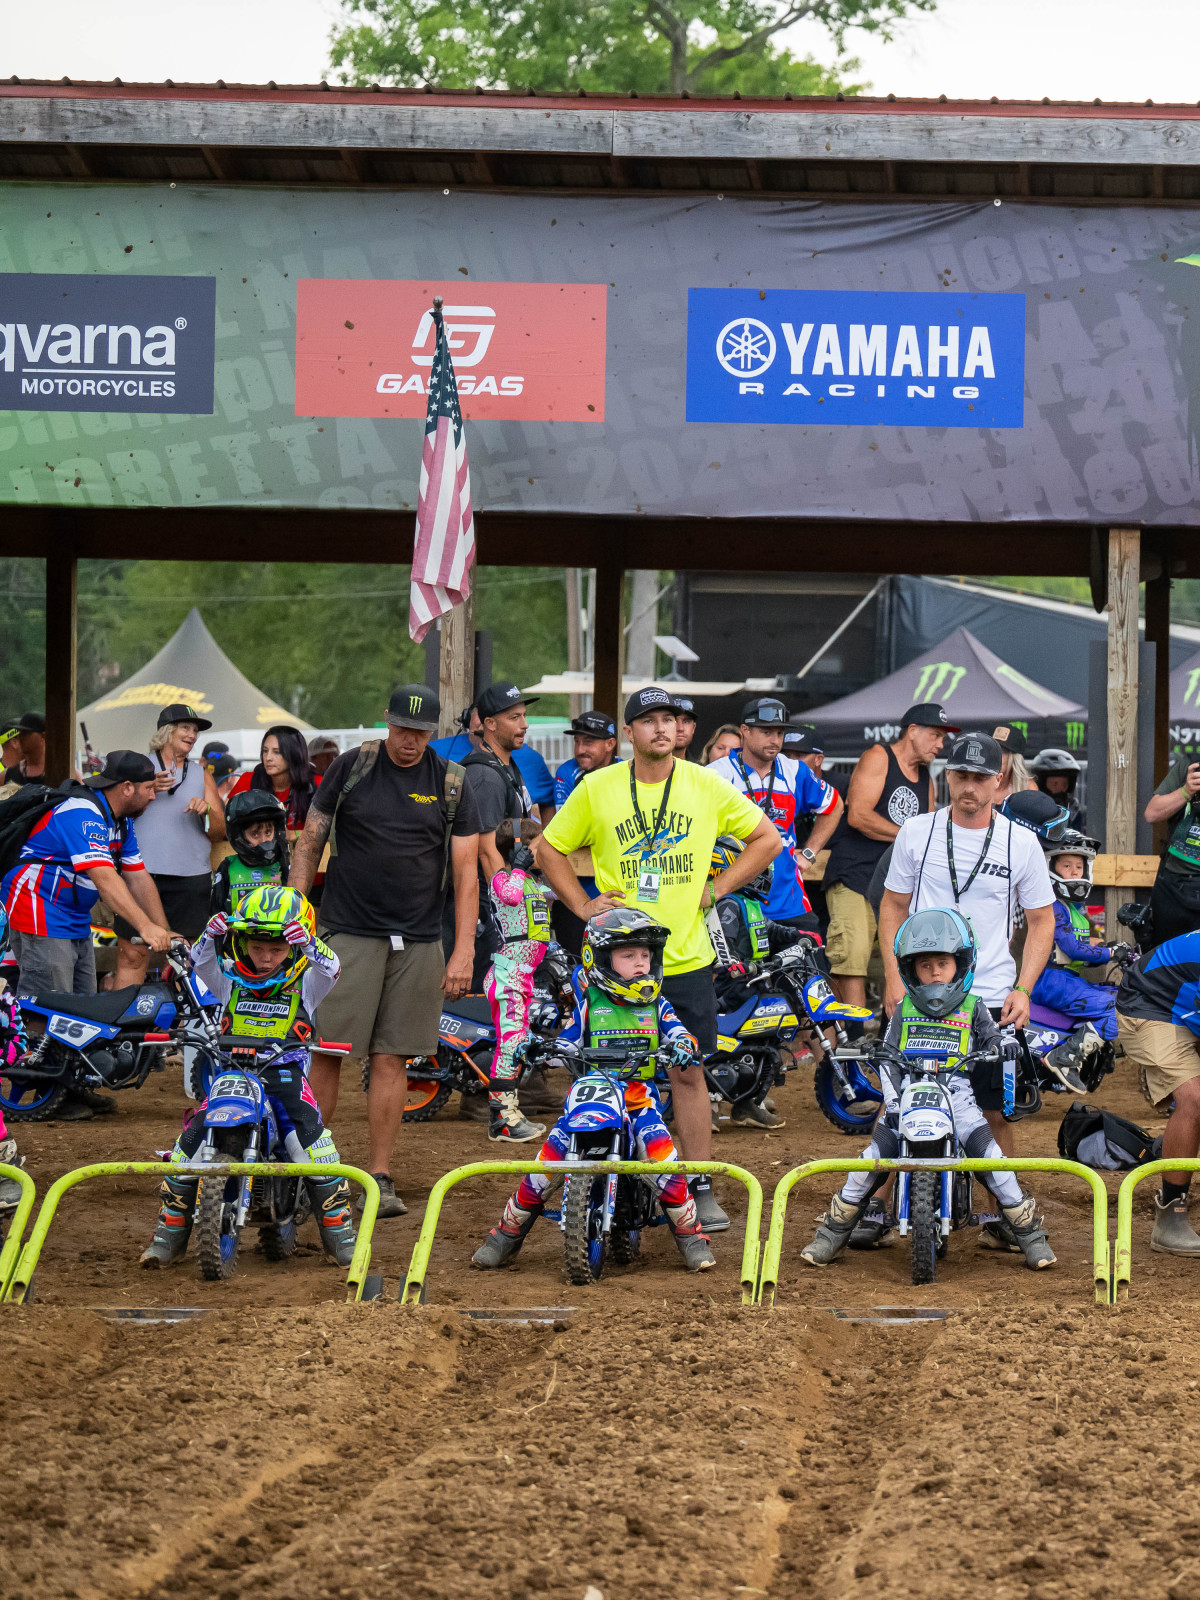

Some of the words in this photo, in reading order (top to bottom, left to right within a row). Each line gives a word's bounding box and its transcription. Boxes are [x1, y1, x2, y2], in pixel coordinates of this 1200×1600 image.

[780, 322, 996, 378] YAMAHA
[21, 378, 176, 398] MOTORCYCLES
[739, 382, 980, 399] RACING
[644, 875, 653, 888] A
[236, 1002, 290, 1015] CHAMPIONSHIP
[54, 1018, 87, 1039] 56
[906, 1040, 960, 1051] CHAMPIONSHIP
[217, 1079, 250, 1097] 23
[575, 1085, 615, 1104] 92
[1003, 1072, 1016, 1117] 100%
[910, 1092, 944, 1108] 99
